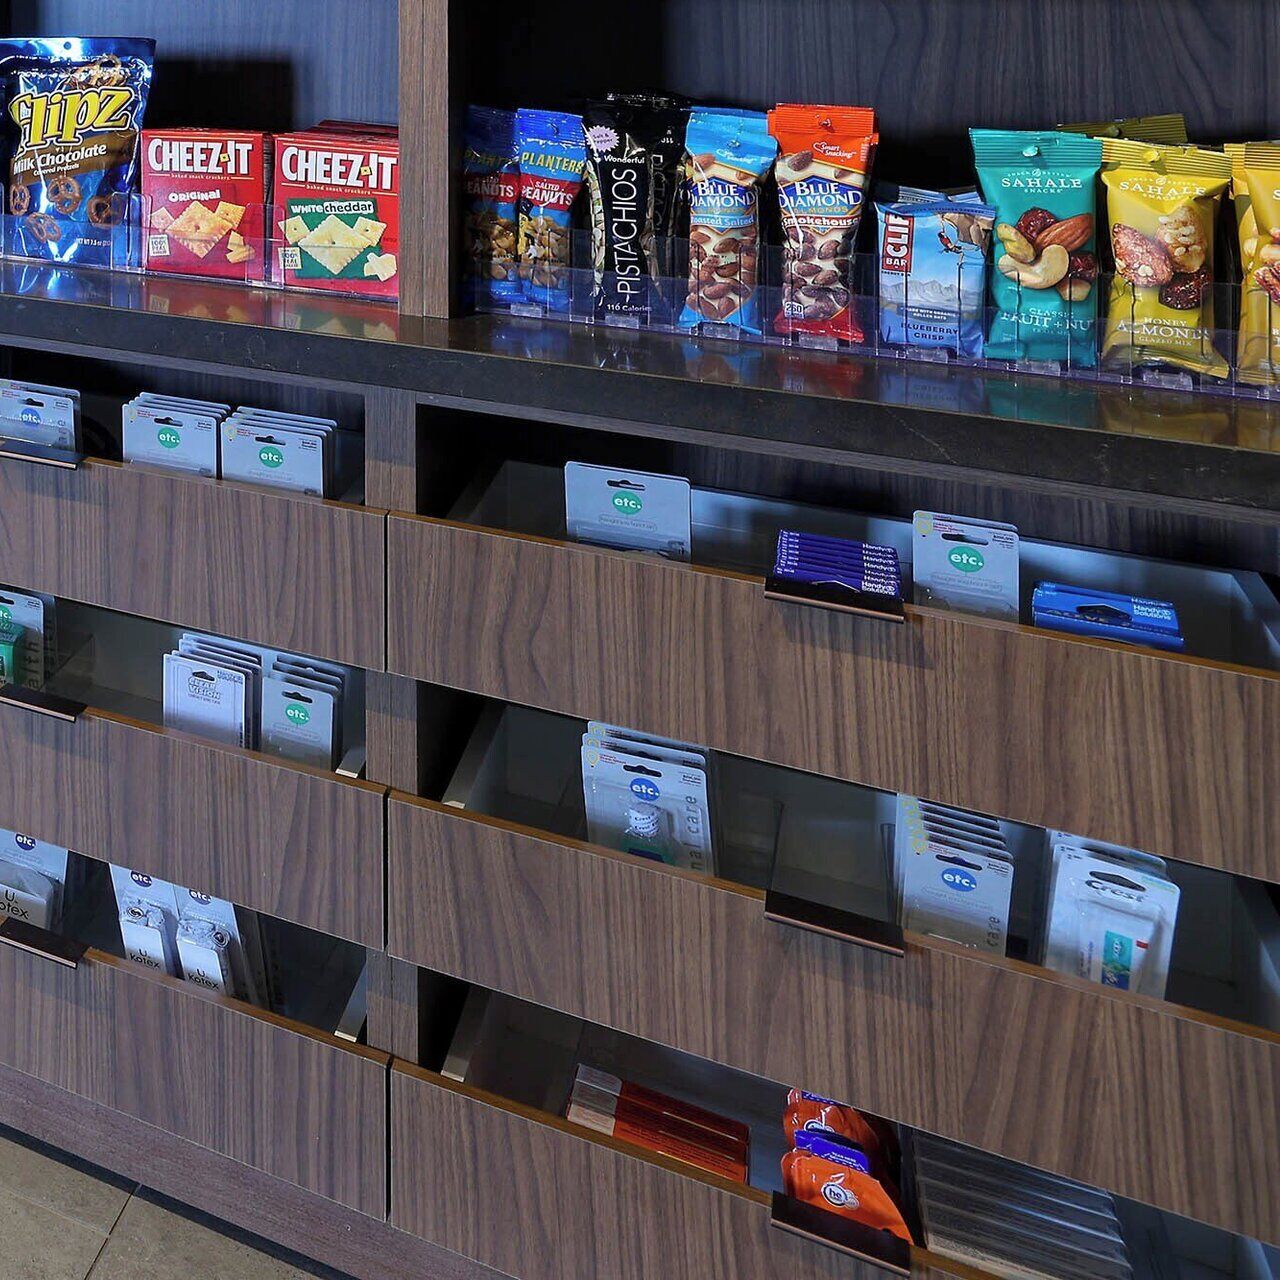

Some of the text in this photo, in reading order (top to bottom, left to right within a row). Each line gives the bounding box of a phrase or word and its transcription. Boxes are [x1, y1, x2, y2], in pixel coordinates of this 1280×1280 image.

[8, 86, 134, 155] Flipz
[13, 144, 107, 176] Milk Chocolate
[521, 152, 585, 174] PLANTERS
[604, 154, 645, 164] Wonderful
[57, 162, 80, 174] Pretzels
[535, 181, 559, 191] SALTED
[698, 182, 739, 196] BLUE
[795, 181, 841, 196] BLUE
[1002, 178, 1082, 189] SAHALE
[1119, 182, 1207, 197] SAHALE
[778, 191, 862, 208] DIAMOND
[291, 201, 374, 214] WHITE cheddar
[611, 168, 641, 298] PISTACHIOS
[885, 213, 914, 257] CLIF
[885, 257, 909, 267] BAR
[607, 303, 620, 313] 116
[1144, 317, 1187, 327] HONEY
[901, 323, 959, 335] BLUEBERRY
[914, 332, 945, 340] CRISP
[160, 433, 180, 443] etc.
[261, 452, 283, 462] etc.
[614, 496, 643, 510] etc.
[950, 554, 983, 567] etc.
[861, 581, 886, 592] Handy
[1134, 605, 1160, 614] Handy
[1134, 609, 1172, 620] Solutions
[286, 707, 310, 720] etc.
[632, 784, 659, 796] etc.
[686, 796, 699, 834] care
[15, 835, 37, 848] etc.
[130, 873, 153, 886] etc.
[943, 873, 975, 889] etc.
[190, 890, 212, 903] etc.
[1085, 879, 1145, 902] Crest
[987, 916, 1000, 946] care
[129, 953, 161, 970] kotex
[188, 972, 220, 990] kotex
